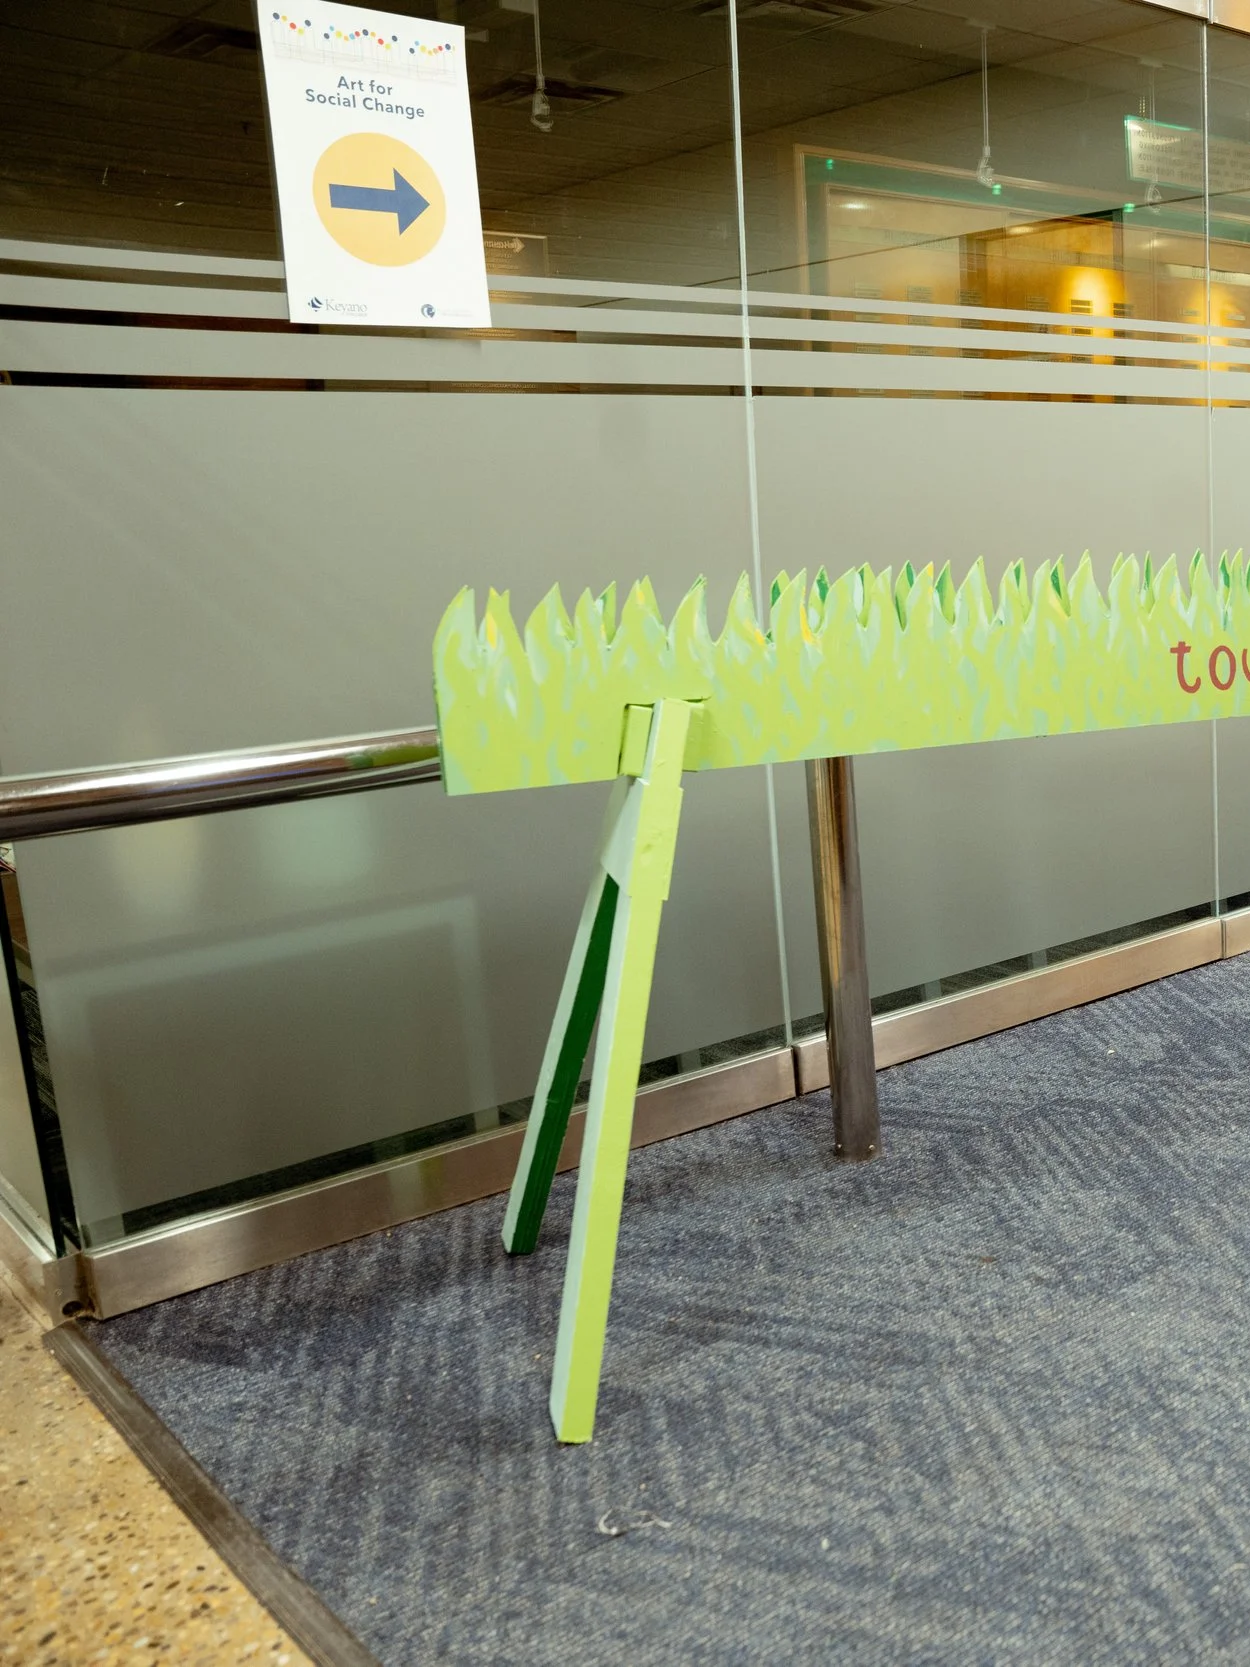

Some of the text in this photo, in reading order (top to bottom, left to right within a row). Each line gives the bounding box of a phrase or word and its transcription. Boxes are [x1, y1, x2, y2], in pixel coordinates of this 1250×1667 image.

[337, 76, 393, 96] Art for
[305, 88, 425, 120] Social Change
[325, 299, 368, 313] Keyano
